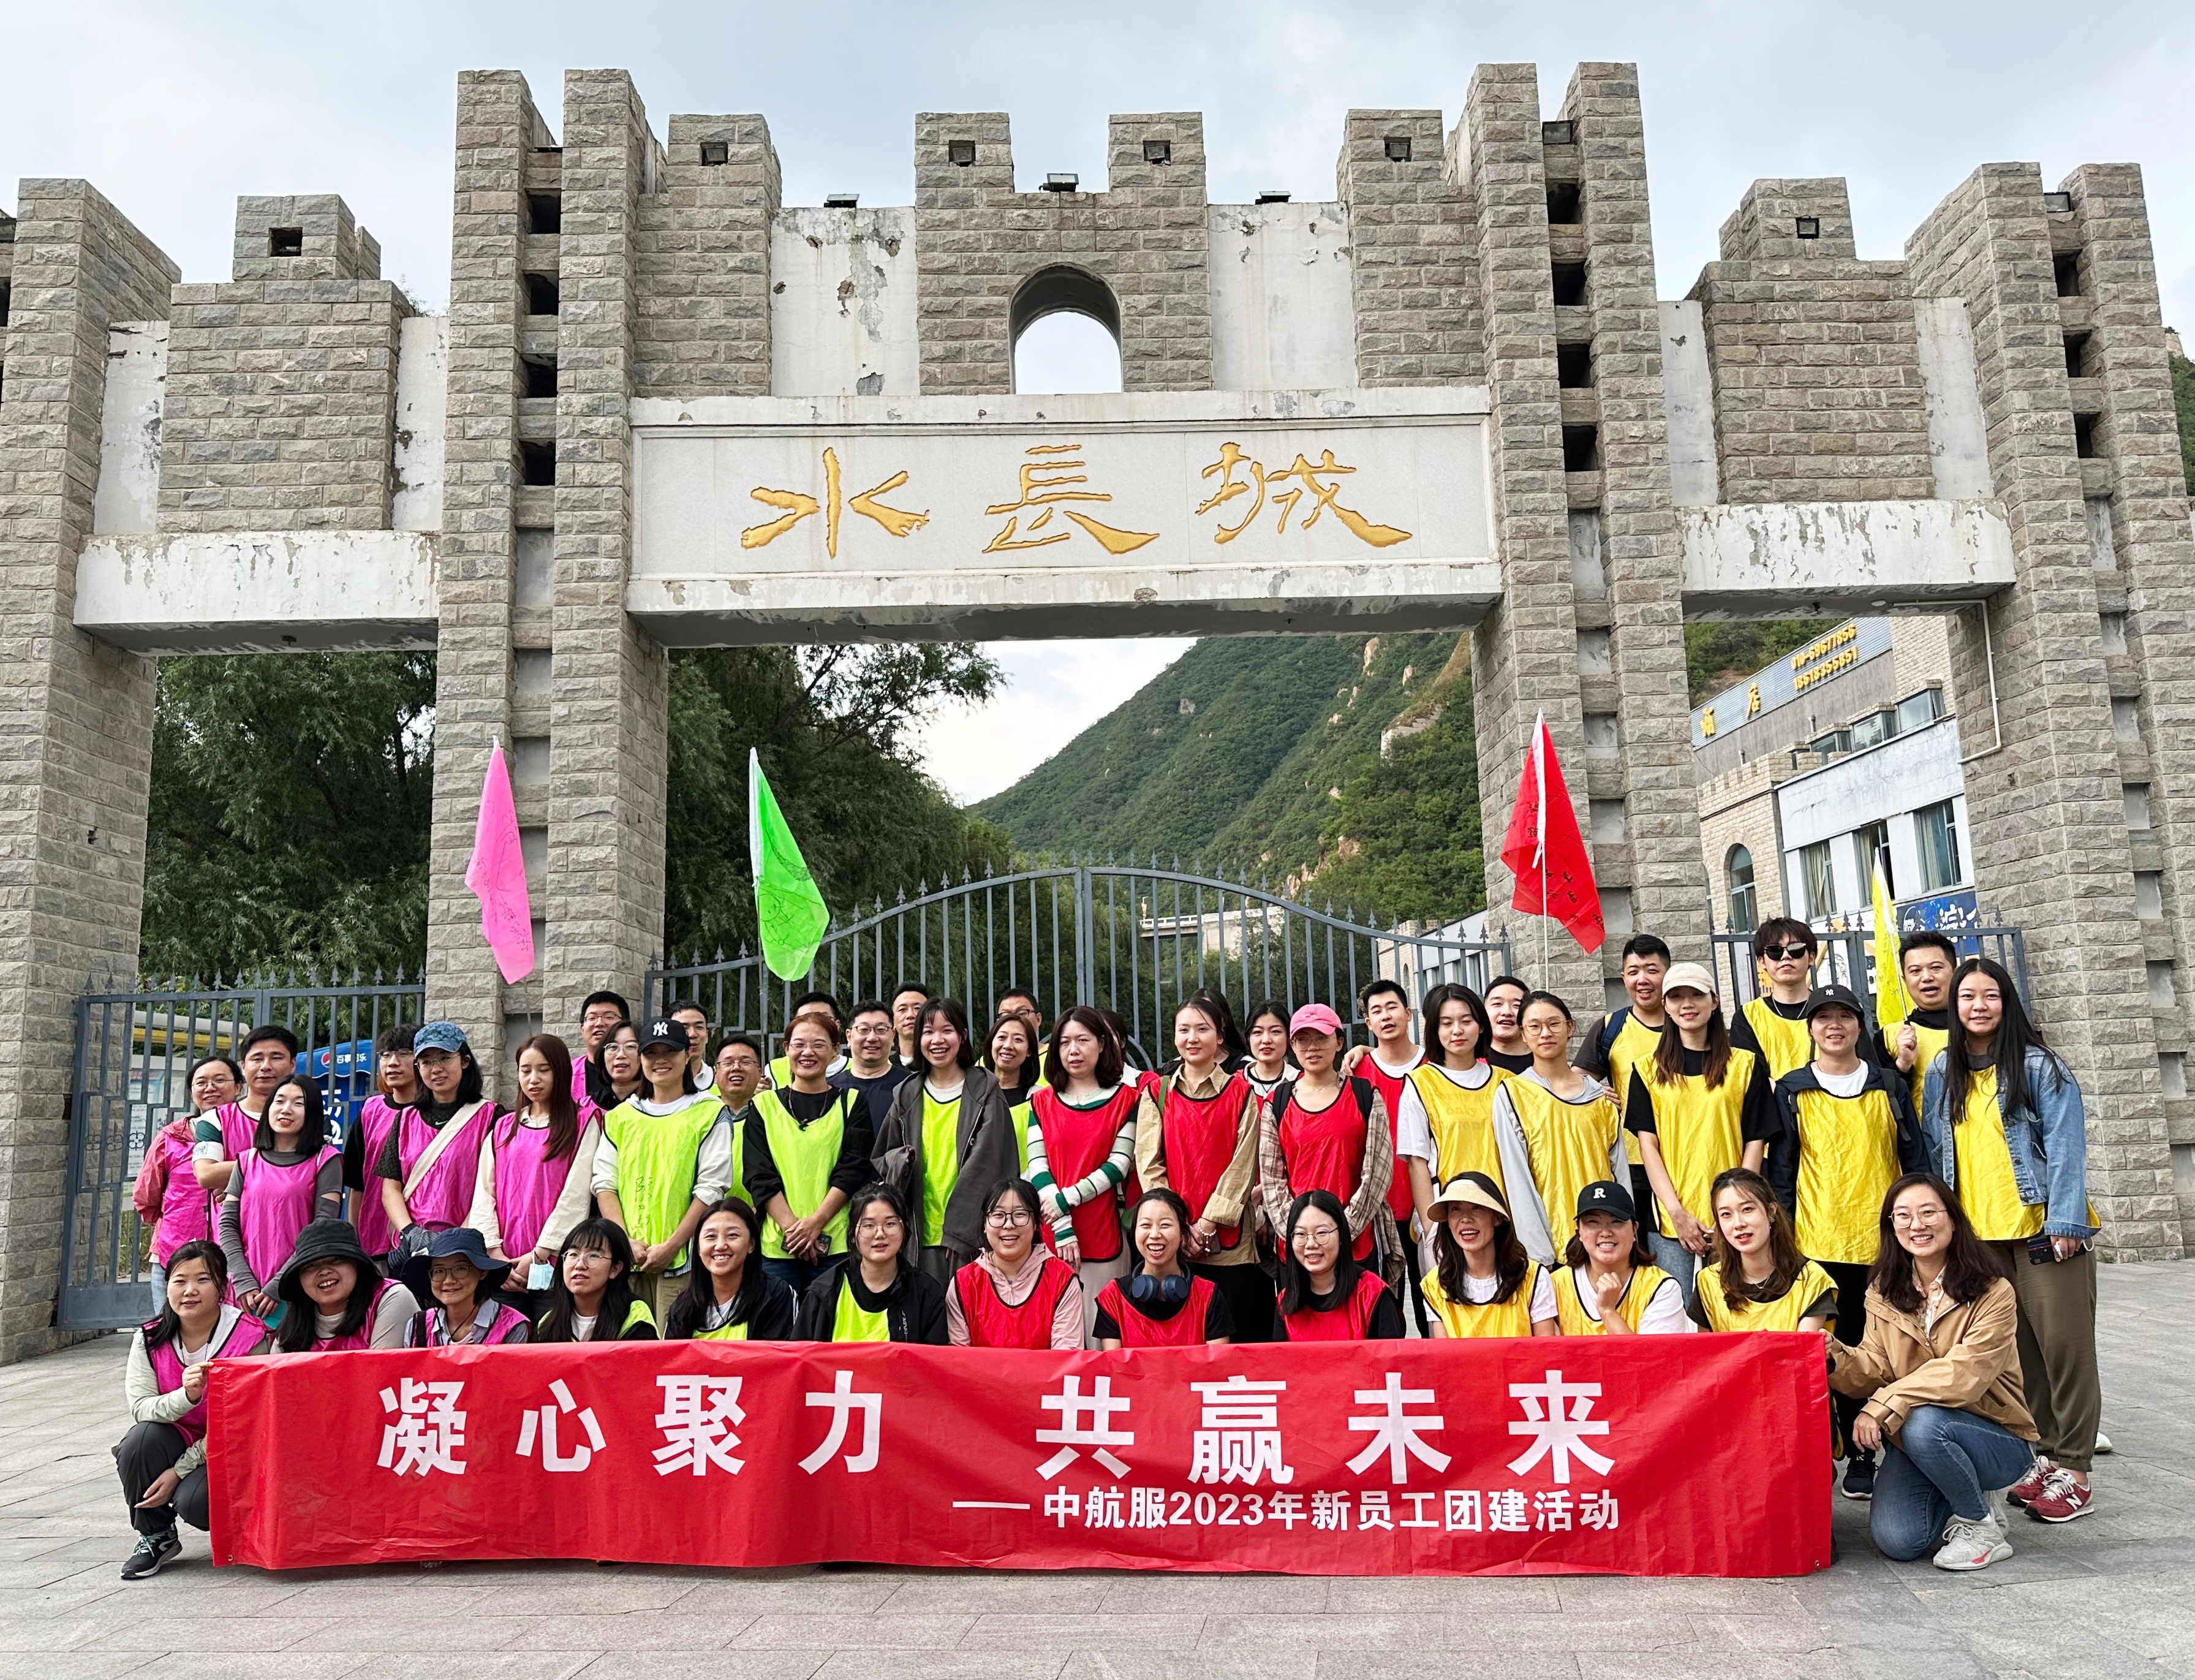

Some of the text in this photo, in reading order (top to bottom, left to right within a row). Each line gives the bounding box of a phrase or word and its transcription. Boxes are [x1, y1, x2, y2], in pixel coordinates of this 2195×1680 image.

[741, 442, 1413, 559] 水長城
[1793, 646, 1859, 691] 18618355851
[653, 1021, 668, 1036] NY
[1593, 1187, 1606, 1199] R
[376, 1369, 1616, 1486] 凝心聚力 共赢未来
[2066, 1493, 2082, 1510] N
